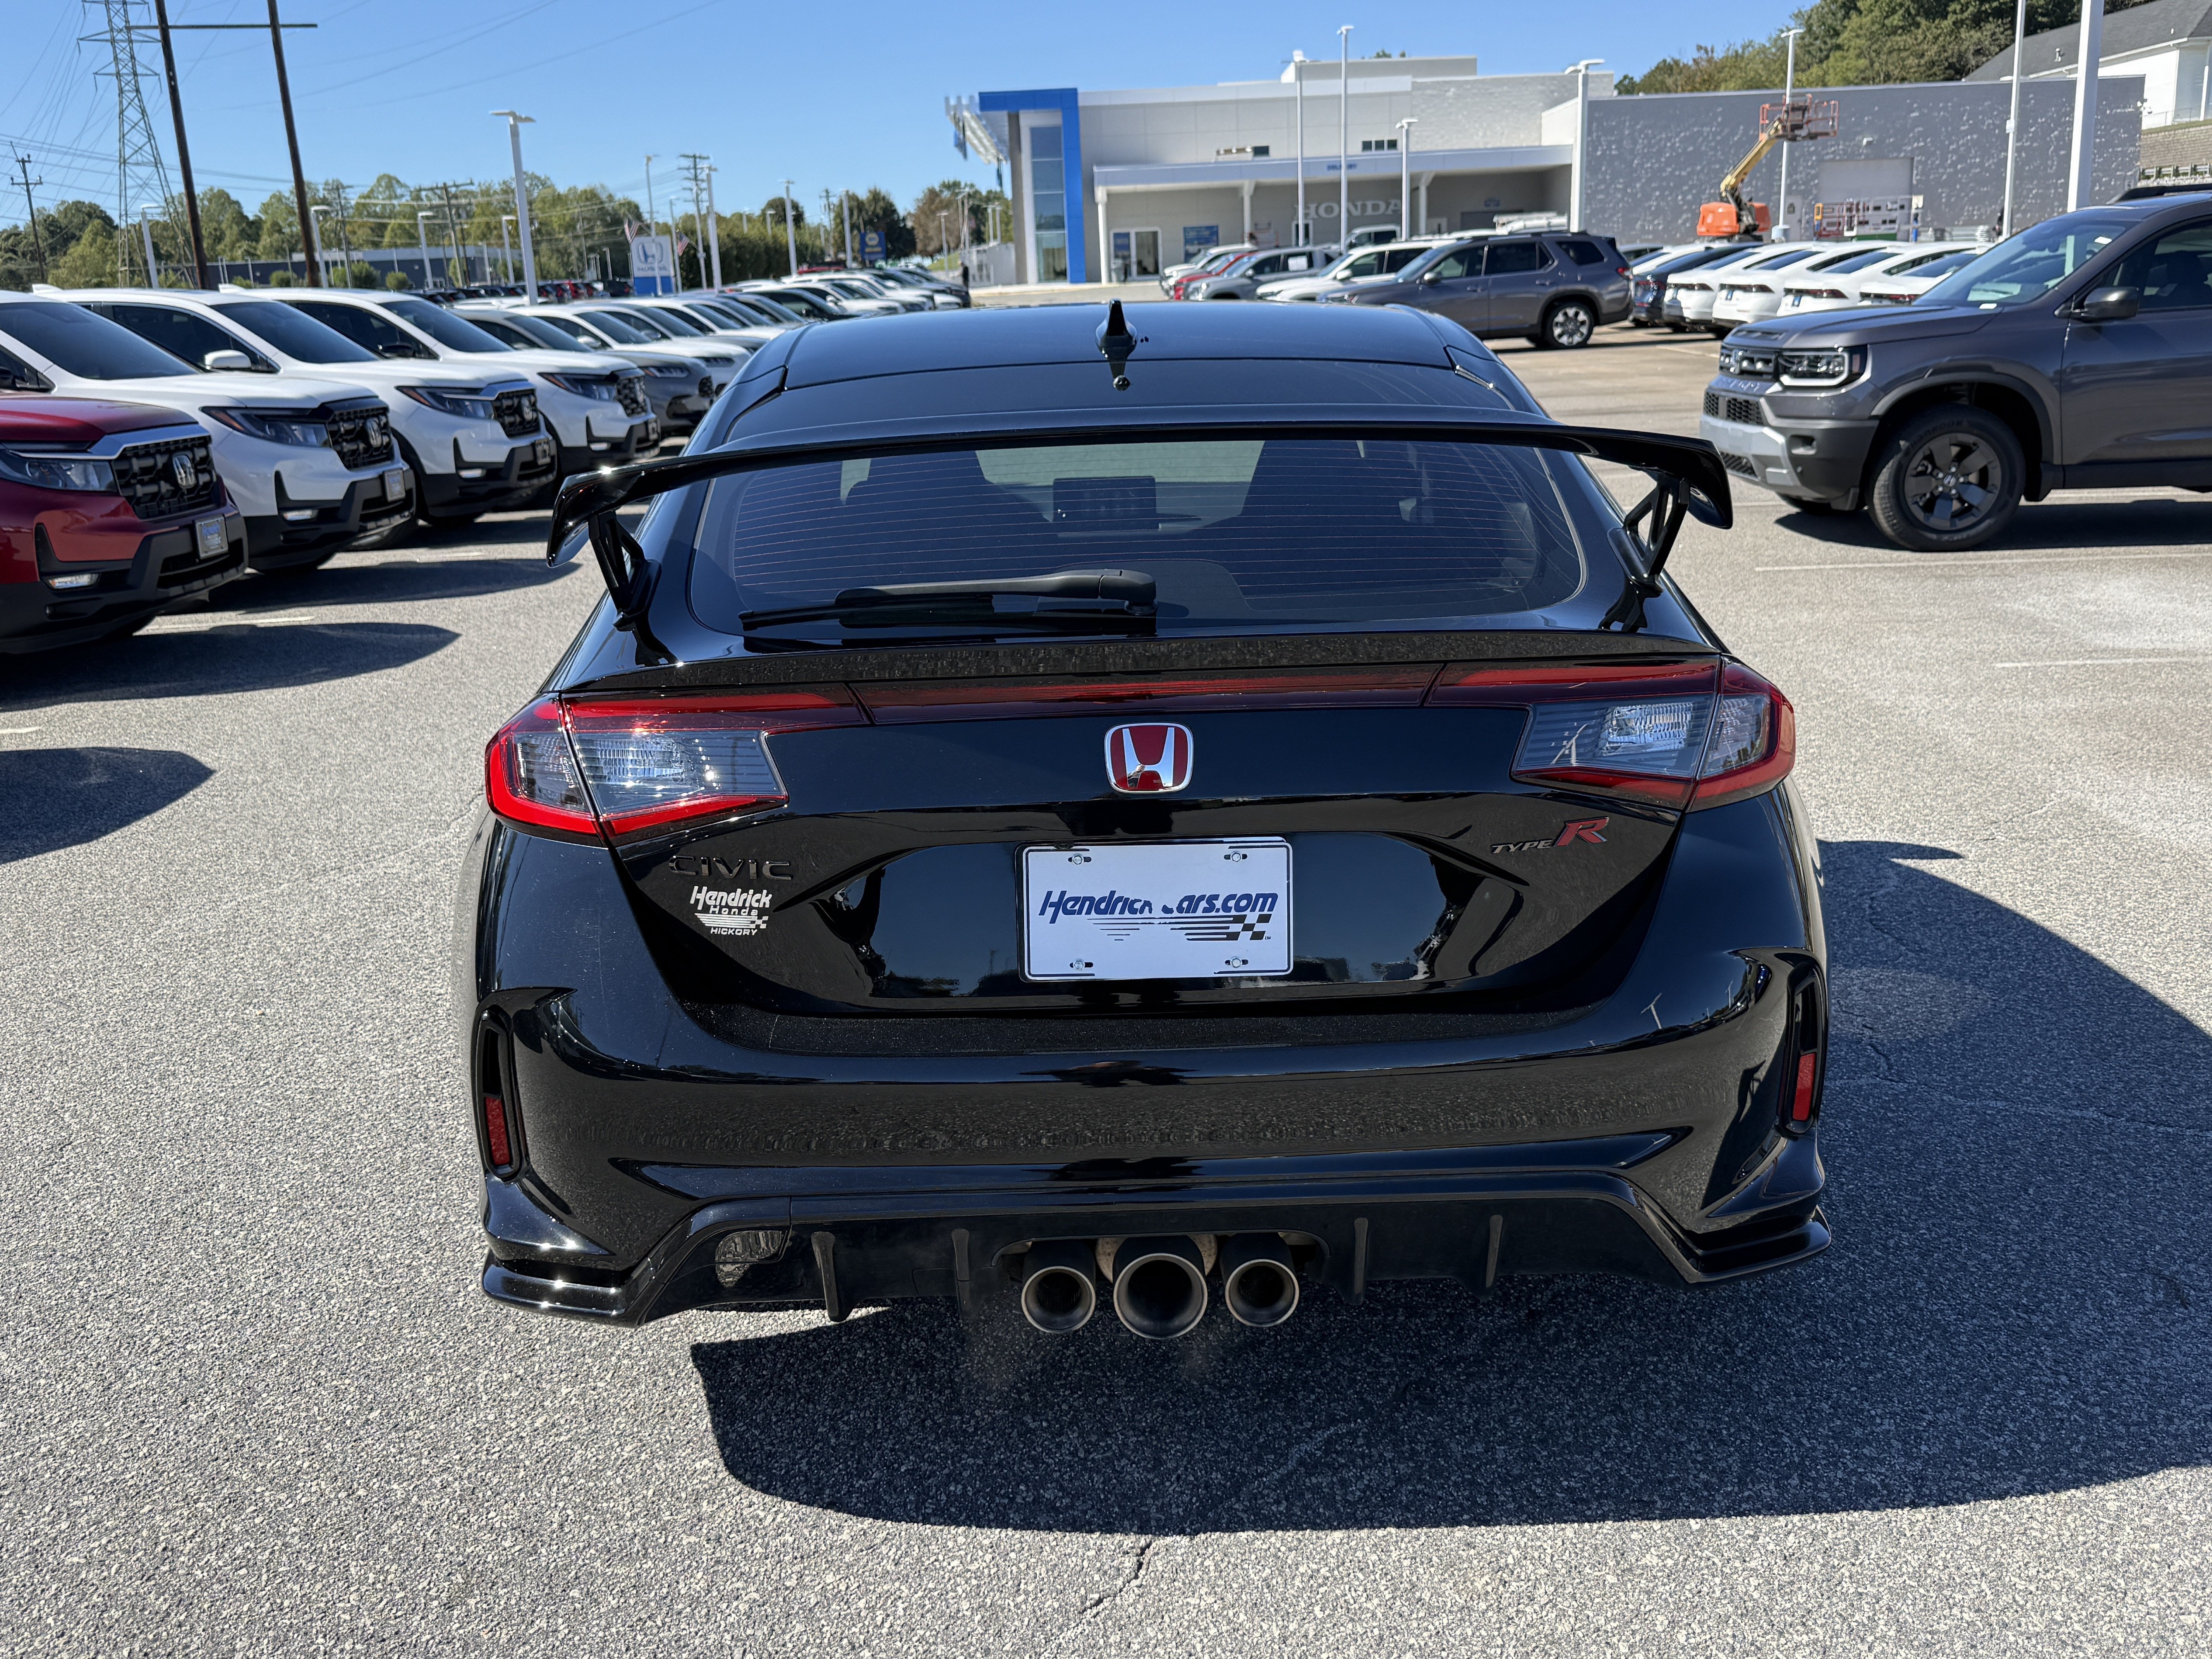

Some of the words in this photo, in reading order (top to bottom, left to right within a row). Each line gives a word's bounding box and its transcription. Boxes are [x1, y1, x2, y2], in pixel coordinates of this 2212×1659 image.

[1293, 199, 1402, 219] HONDA
[1491, 839, 1553, 854] TYPE
[1553, 816, 1609, 847] R
[668, 855, 792, 880] CIVIC
[690, 886, 772, 910] Hendrick
[709, 905, 758, 915] Honda
[1038, 890, 1278, 924] Hendricars.com
[710, 927, 758, 936] HICKORY
